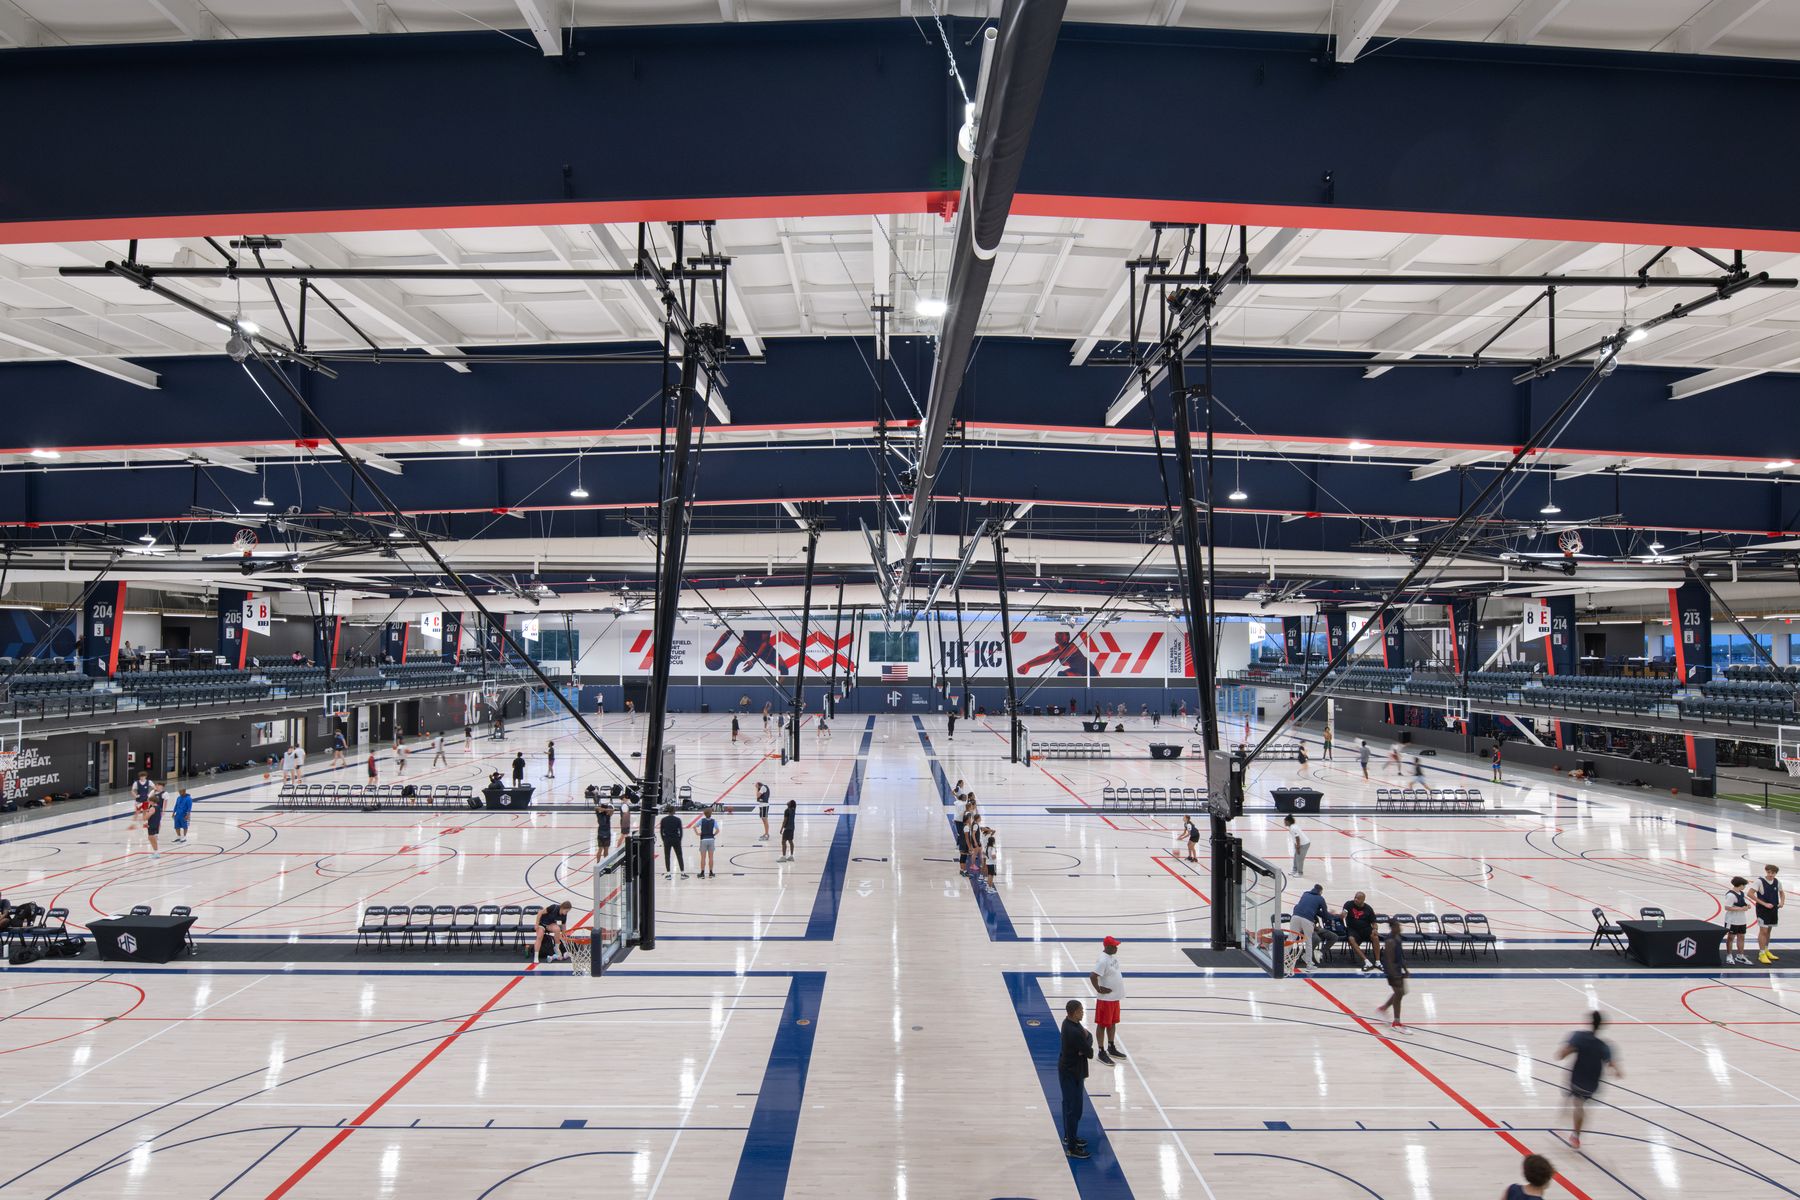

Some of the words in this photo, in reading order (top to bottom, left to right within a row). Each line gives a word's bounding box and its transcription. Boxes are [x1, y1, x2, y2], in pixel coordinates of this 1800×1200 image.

[93, 605, 112, 618] 204
[225, 613, 241, 623] 205
[246, 605, 253, 618] 3
[260, 605, 267, 618] B
[1527, 612, 1534, 624] 8
[1541, 611, 1547, 624] E
[424, 617, 429, 626] 4
[434, 617, 439, 626] C
[1553, 619, 1567, 629] 214
[1684, 612, 1700, 625] 213
[941, 641, 969, 667] HF
[974, 641, 1002, 668] KC
[464, 691, 480, 725] KC
[12, 756, 51, 770] REPEAT.
[20, 773, 60, 788] REPEAT.
[119, 934, 137, 953] HF
[1678, 939, 1696, 958] HF
